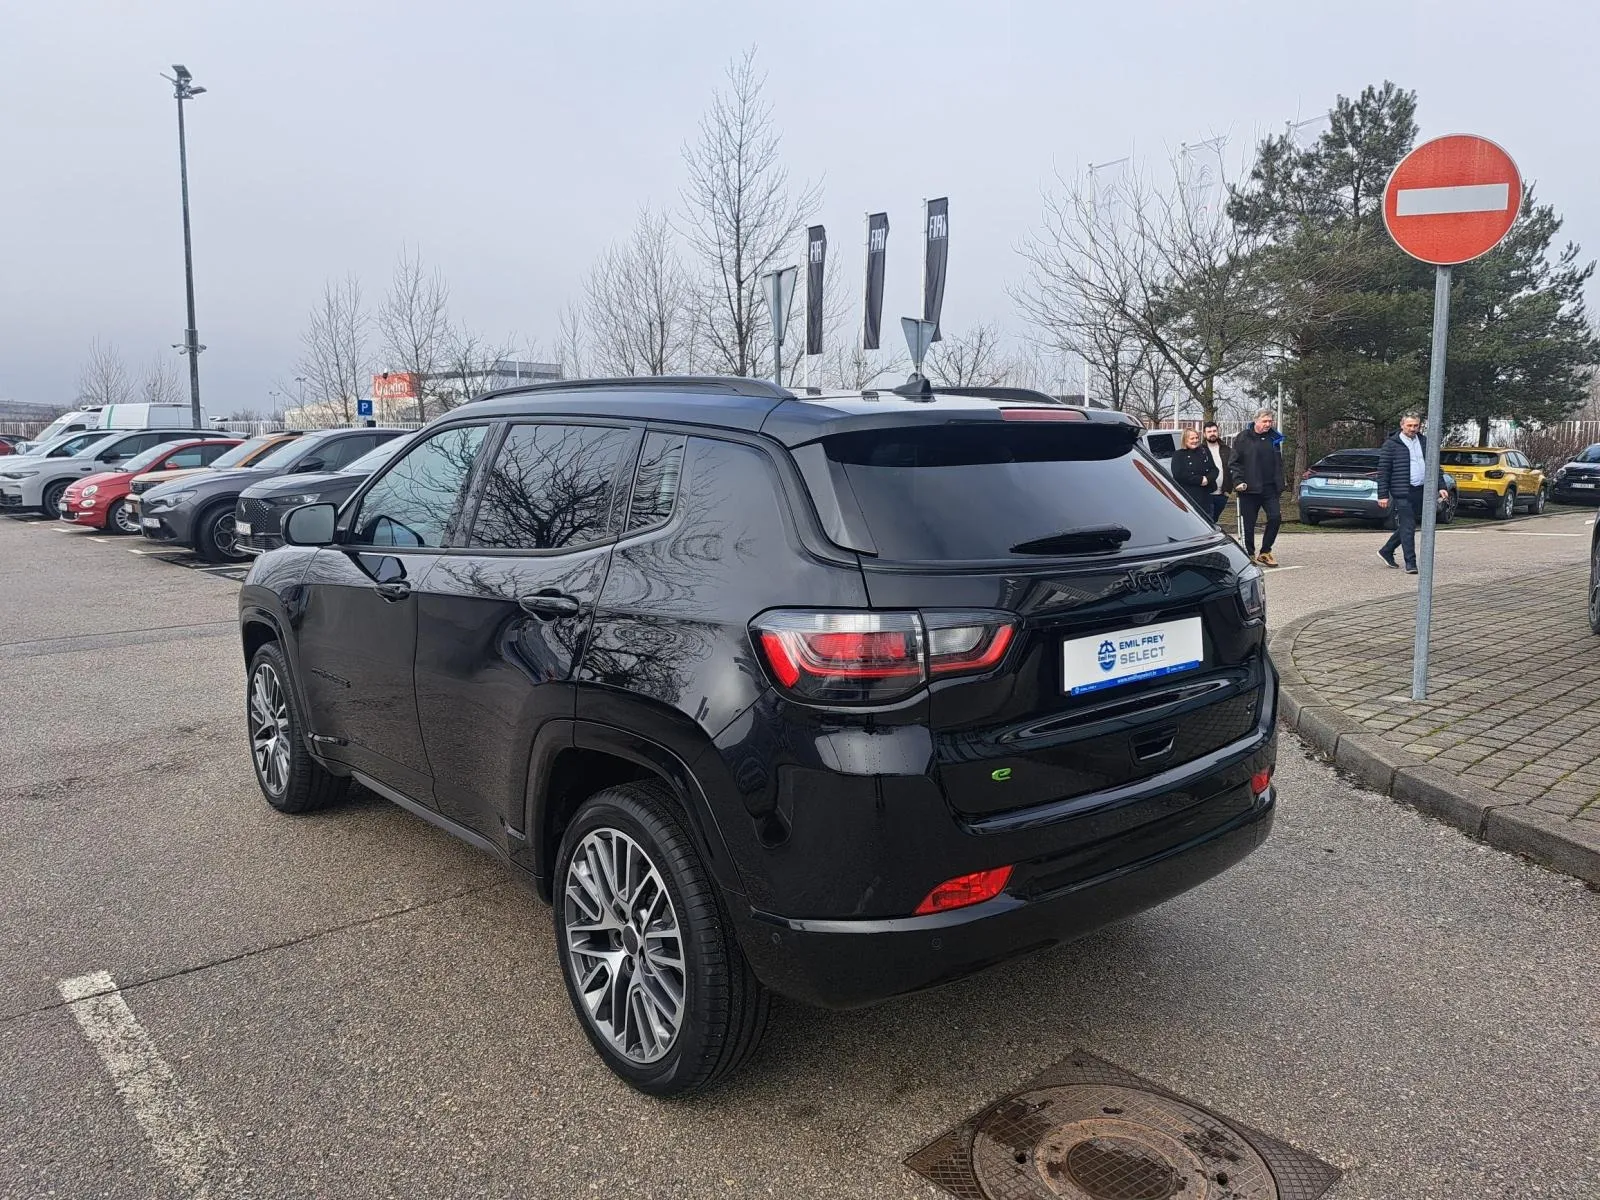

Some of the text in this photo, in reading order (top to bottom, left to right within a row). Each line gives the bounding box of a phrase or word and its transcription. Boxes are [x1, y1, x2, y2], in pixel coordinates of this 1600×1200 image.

[811, 240, 823, 262] FIA
[362, 403, 369, 412] P
[1126, 570, 1171, 595] Jeep
[1120, 634, 1164, 649] EMIL FREY
[1120, 646, 1165, 664] SELECT
